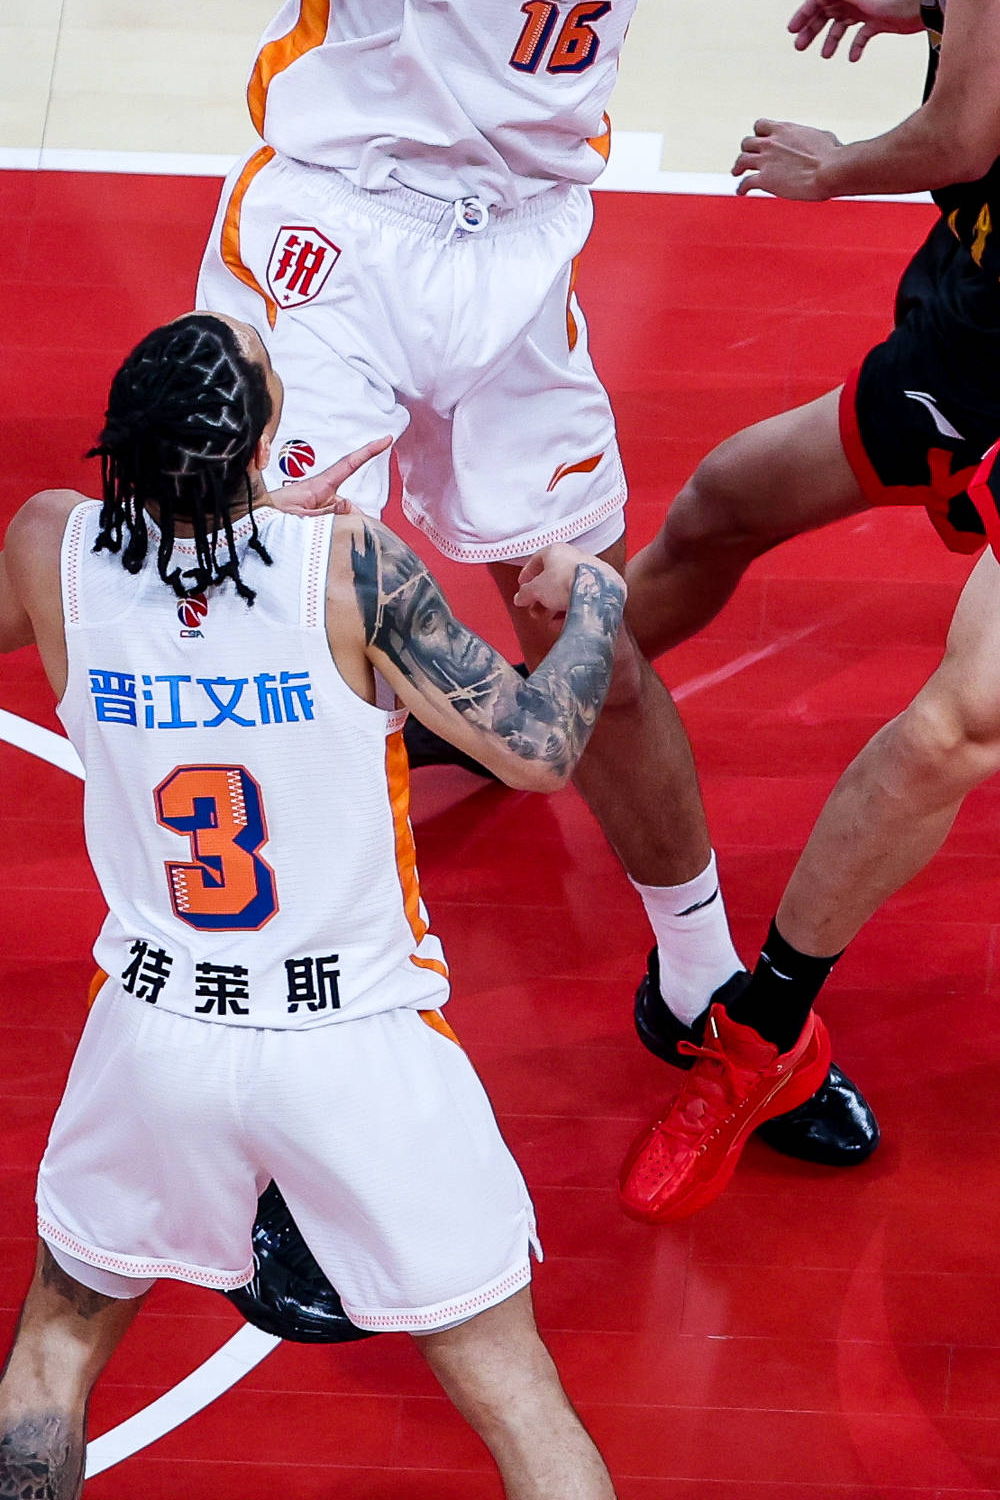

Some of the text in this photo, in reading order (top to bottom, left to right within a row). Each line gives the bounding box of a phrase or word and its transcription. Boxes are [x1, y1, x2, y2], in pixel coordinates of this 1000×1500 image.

[88, 668, 315, 729] 晋江文旅
[153, 763, 279, 932] 3
[121, 939, 343, 1016] 特莱斯
